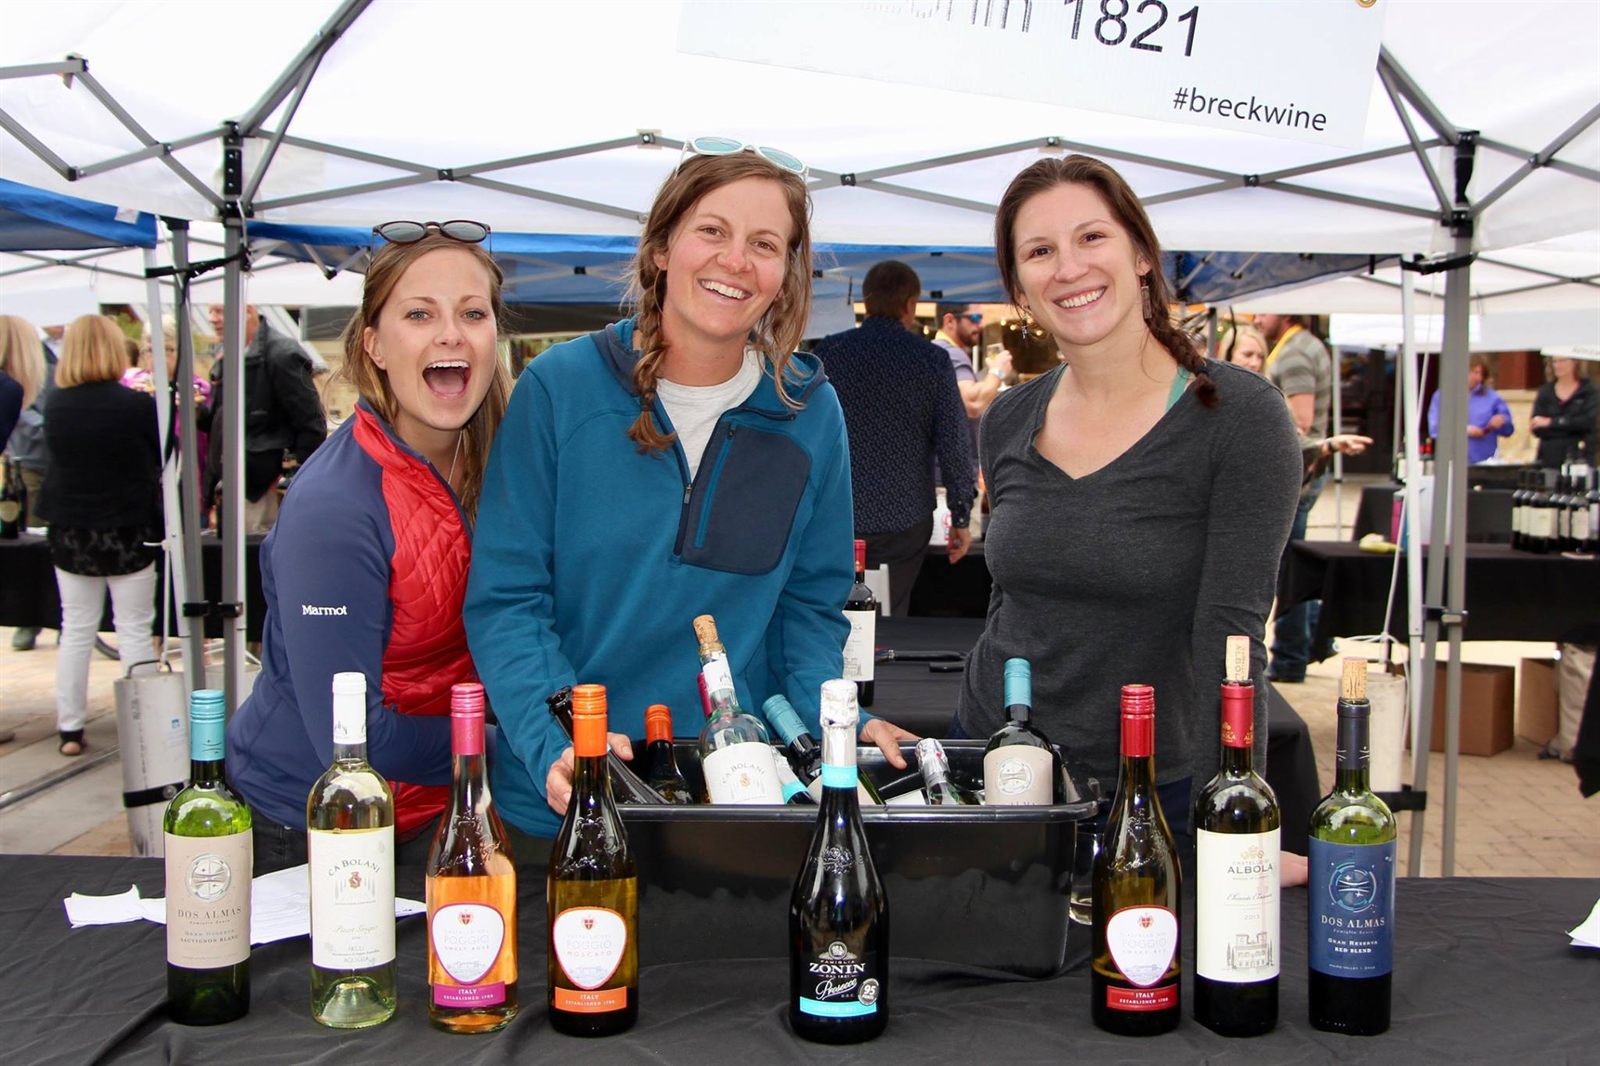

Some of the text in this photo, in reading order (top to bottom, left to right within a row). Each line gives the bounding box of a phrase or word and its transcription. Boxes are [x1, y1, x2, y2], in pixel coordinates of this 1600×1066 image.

[1062, 0, 1200, 57] 1821
[1172, 86, 1327, 132] #breckwine
[302, 604, 348, 616] Marmot
[1227, 863, 1273, 874] ALBOLA
[178, 905, 242, 920] DOS ALMAS
[1321, 914, 1385, 928] DOS ALMAS
[809, 962, 866, 974] ZONIN
[815, 978, 858, 1000] Prosecco
[863, 984, 876, 996] 95
